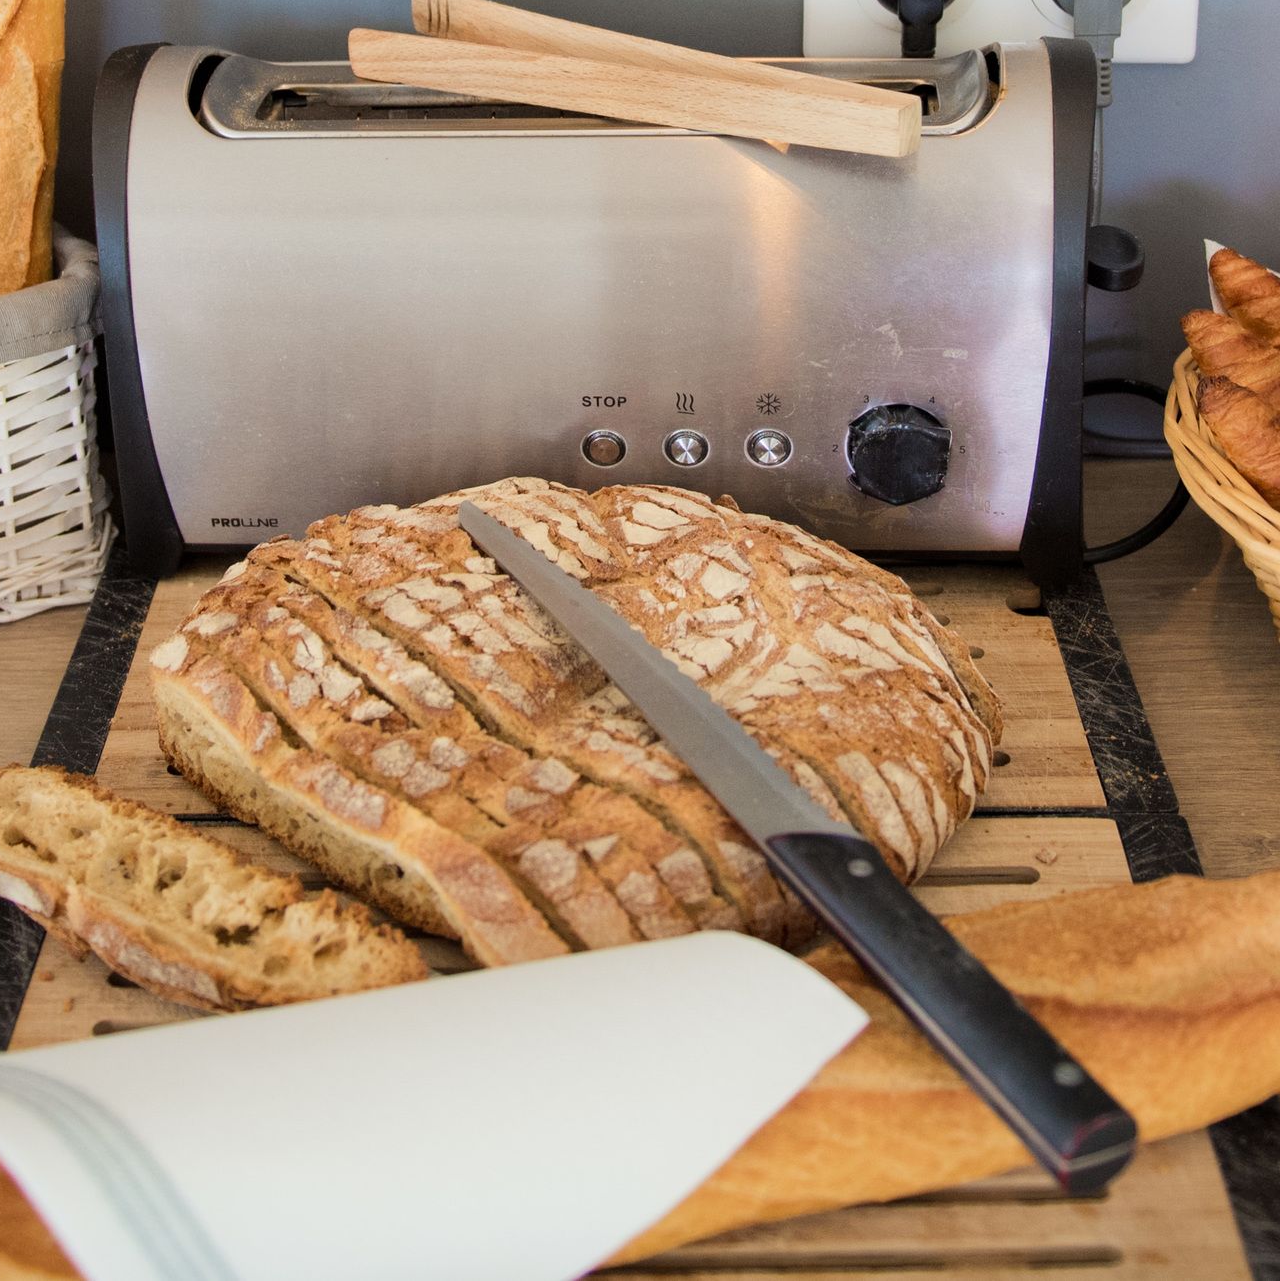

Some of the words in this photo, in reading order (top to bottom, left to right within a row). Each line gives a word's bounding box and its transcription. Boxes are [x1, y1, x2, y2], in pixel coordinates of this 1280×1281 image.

[581, 395, 627, 408] STOP
[863, 394, 870, 404] 3
[928, 396, 936, 405] 4
[832, 444, 839, 453] 2
[959, 445, 966, 454] 5
